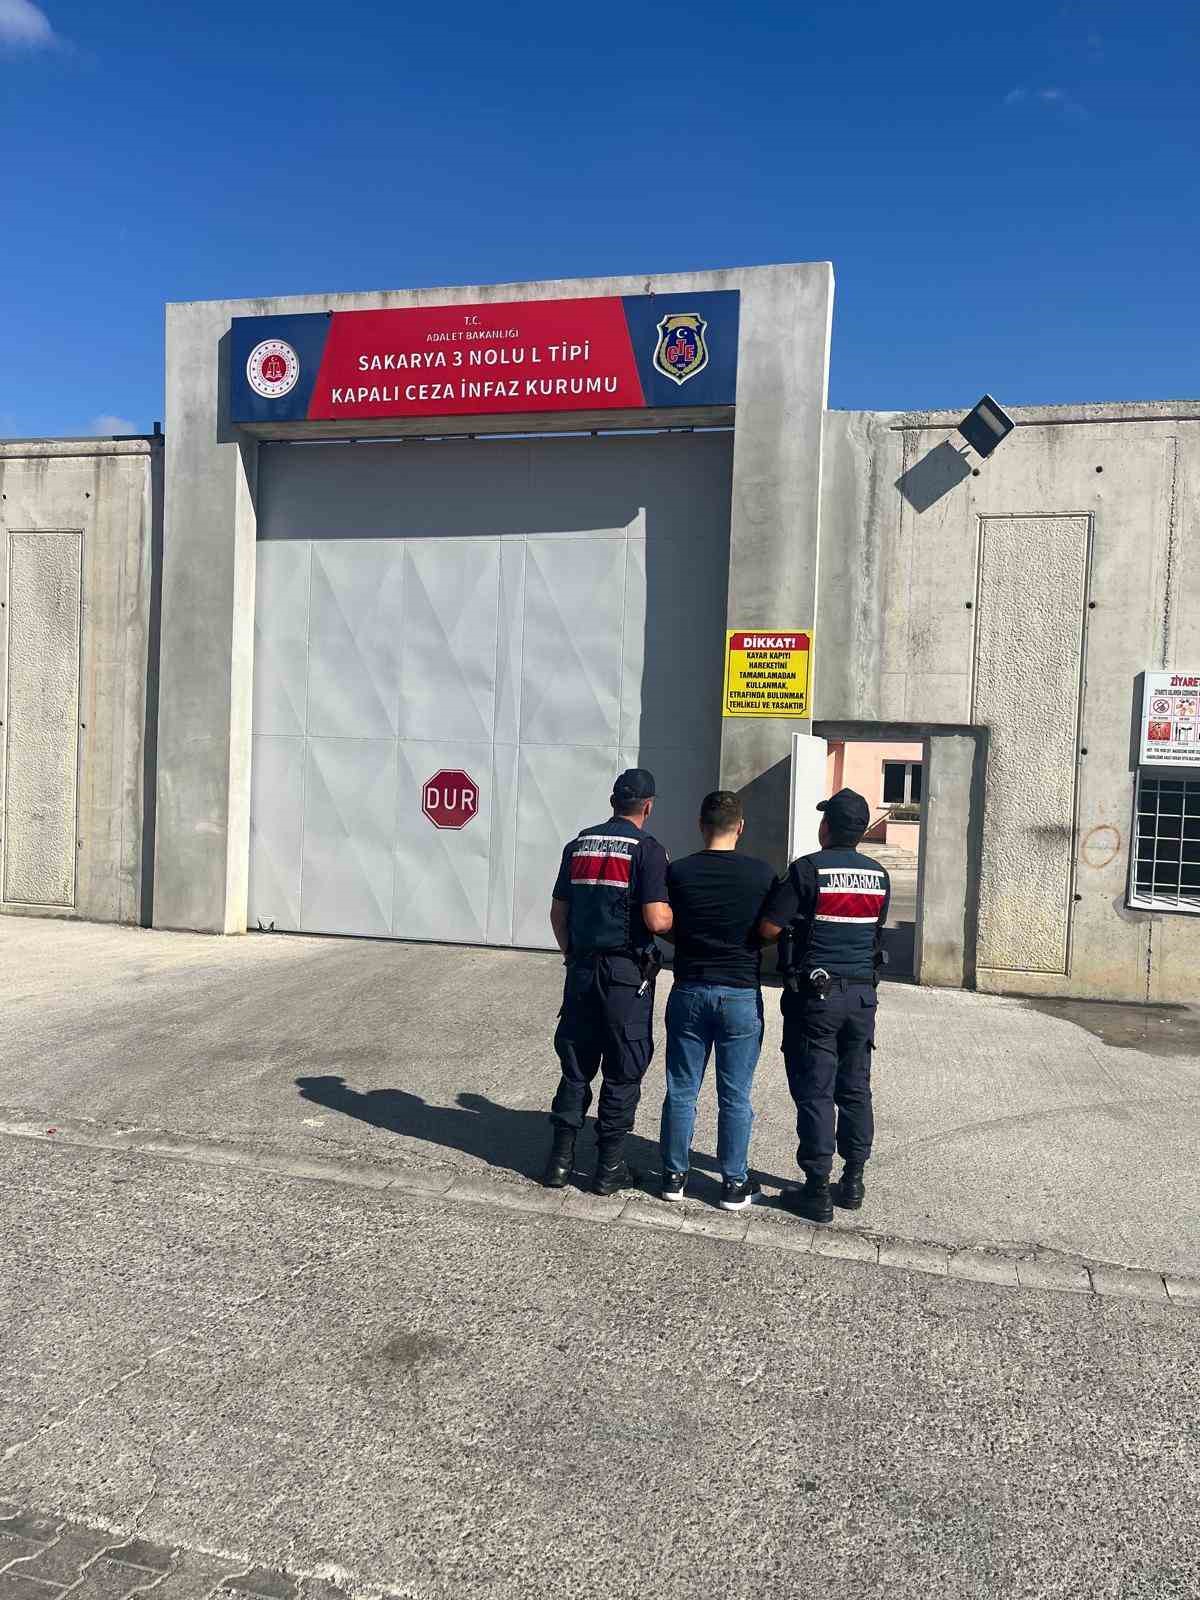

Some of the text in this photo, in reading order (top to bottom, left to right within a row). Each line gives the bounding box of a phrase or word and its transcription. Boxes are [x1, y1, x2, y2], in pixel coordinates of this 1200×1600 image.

[464, 315, 481, 326] T.C.
[426, 329, 519, 342] ADALET BAKANLIĞI
[358, 340, 589, 371] SAKARYA 3 NOLU L TİPİ
[332, 376, 617, 404] KAPALI CEZA İNFAZ KURUMU
[743, 635, 796, 648] DİKKAT!
[749, 661, 787, 669] HAREKETİNİ
[739, 672, 796, 680] TAMAMLAMADAN
[729, 691, 765, 699] ETRAFINDA
[730, 701, 760, 709] TEHLİKELİ
[772, 702, 804, 710] YASAKTIR
[427, 788, 474, 810] DUR
[827, 873, 881, 889] JANDARMA
